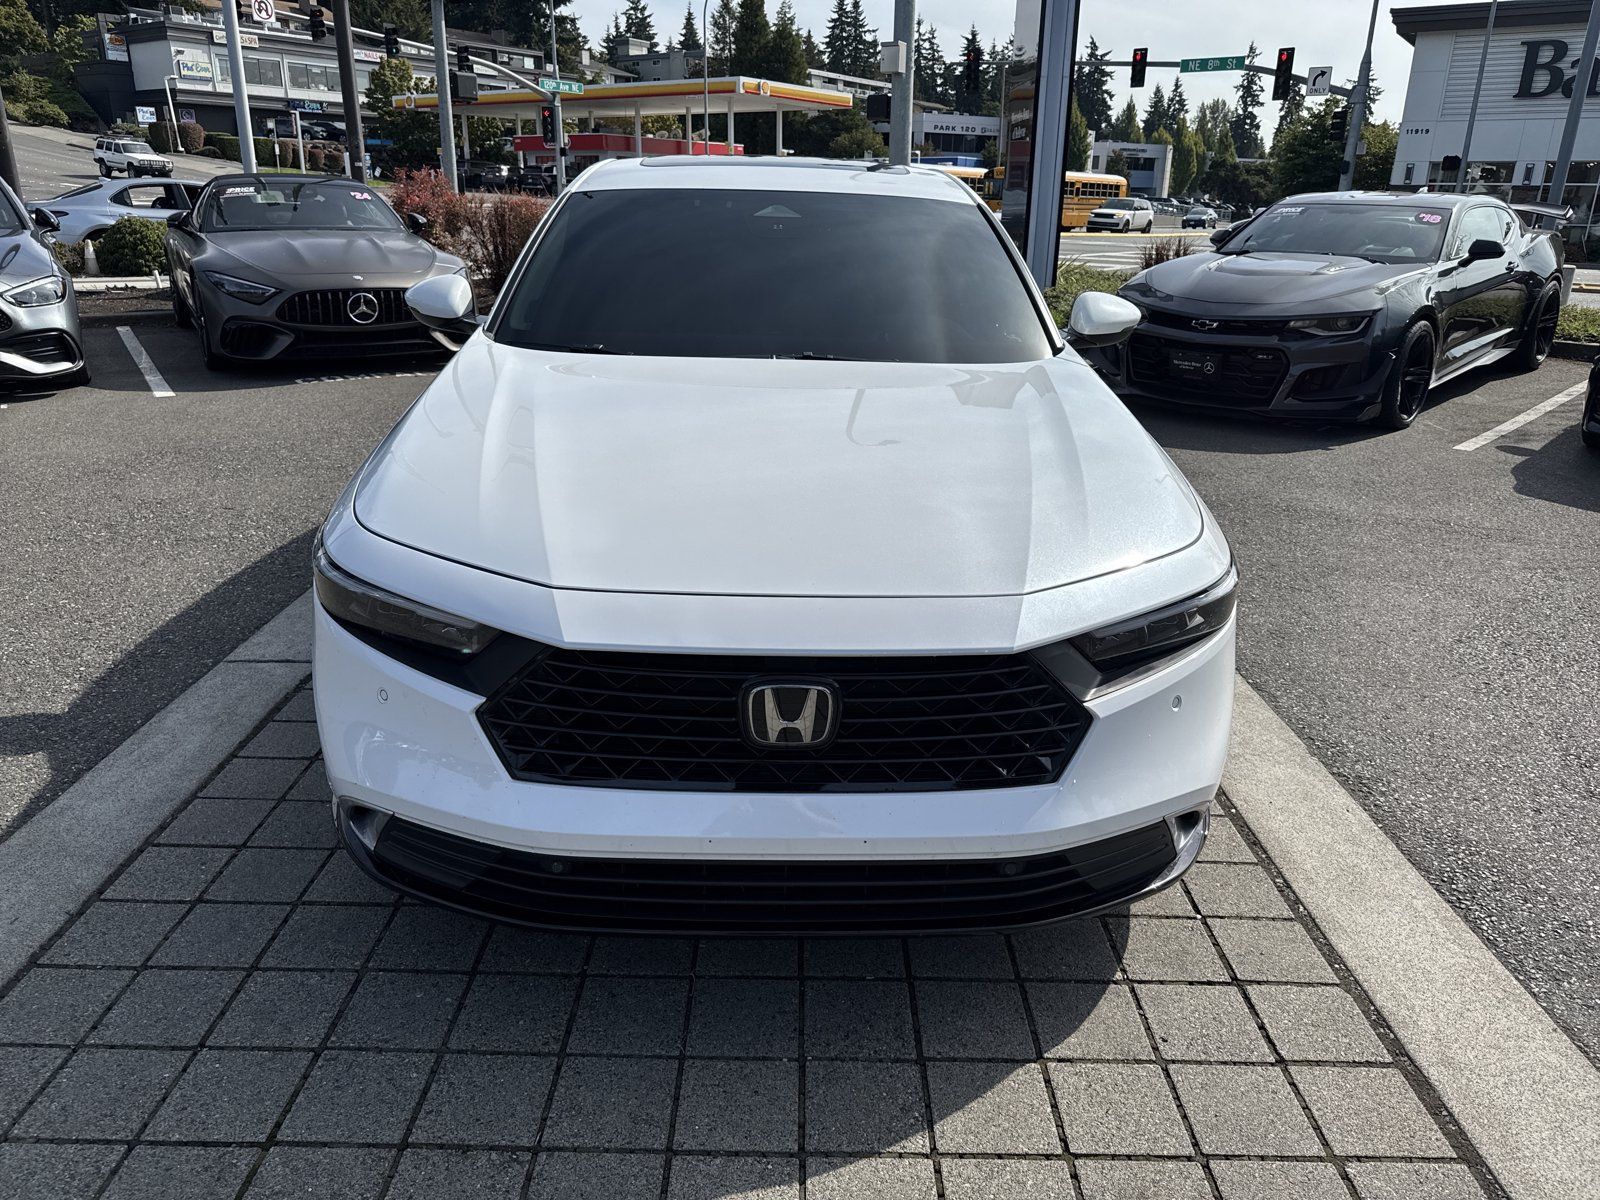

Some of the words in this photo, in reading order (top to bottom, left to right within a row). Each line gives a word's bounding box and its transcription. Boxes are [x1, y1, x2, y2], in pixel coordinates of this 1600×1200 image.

[1188, 60, 1201, 71] NE
[1207, 59, 1220, 70] 8th
[1226, 58, 1237, 69] St
[544, 80, 557, 90] 120th
[560, 82, 569, 91] Ave
[571, 83, 579, 92] NE
[933, 124, 957, 132] PARK
